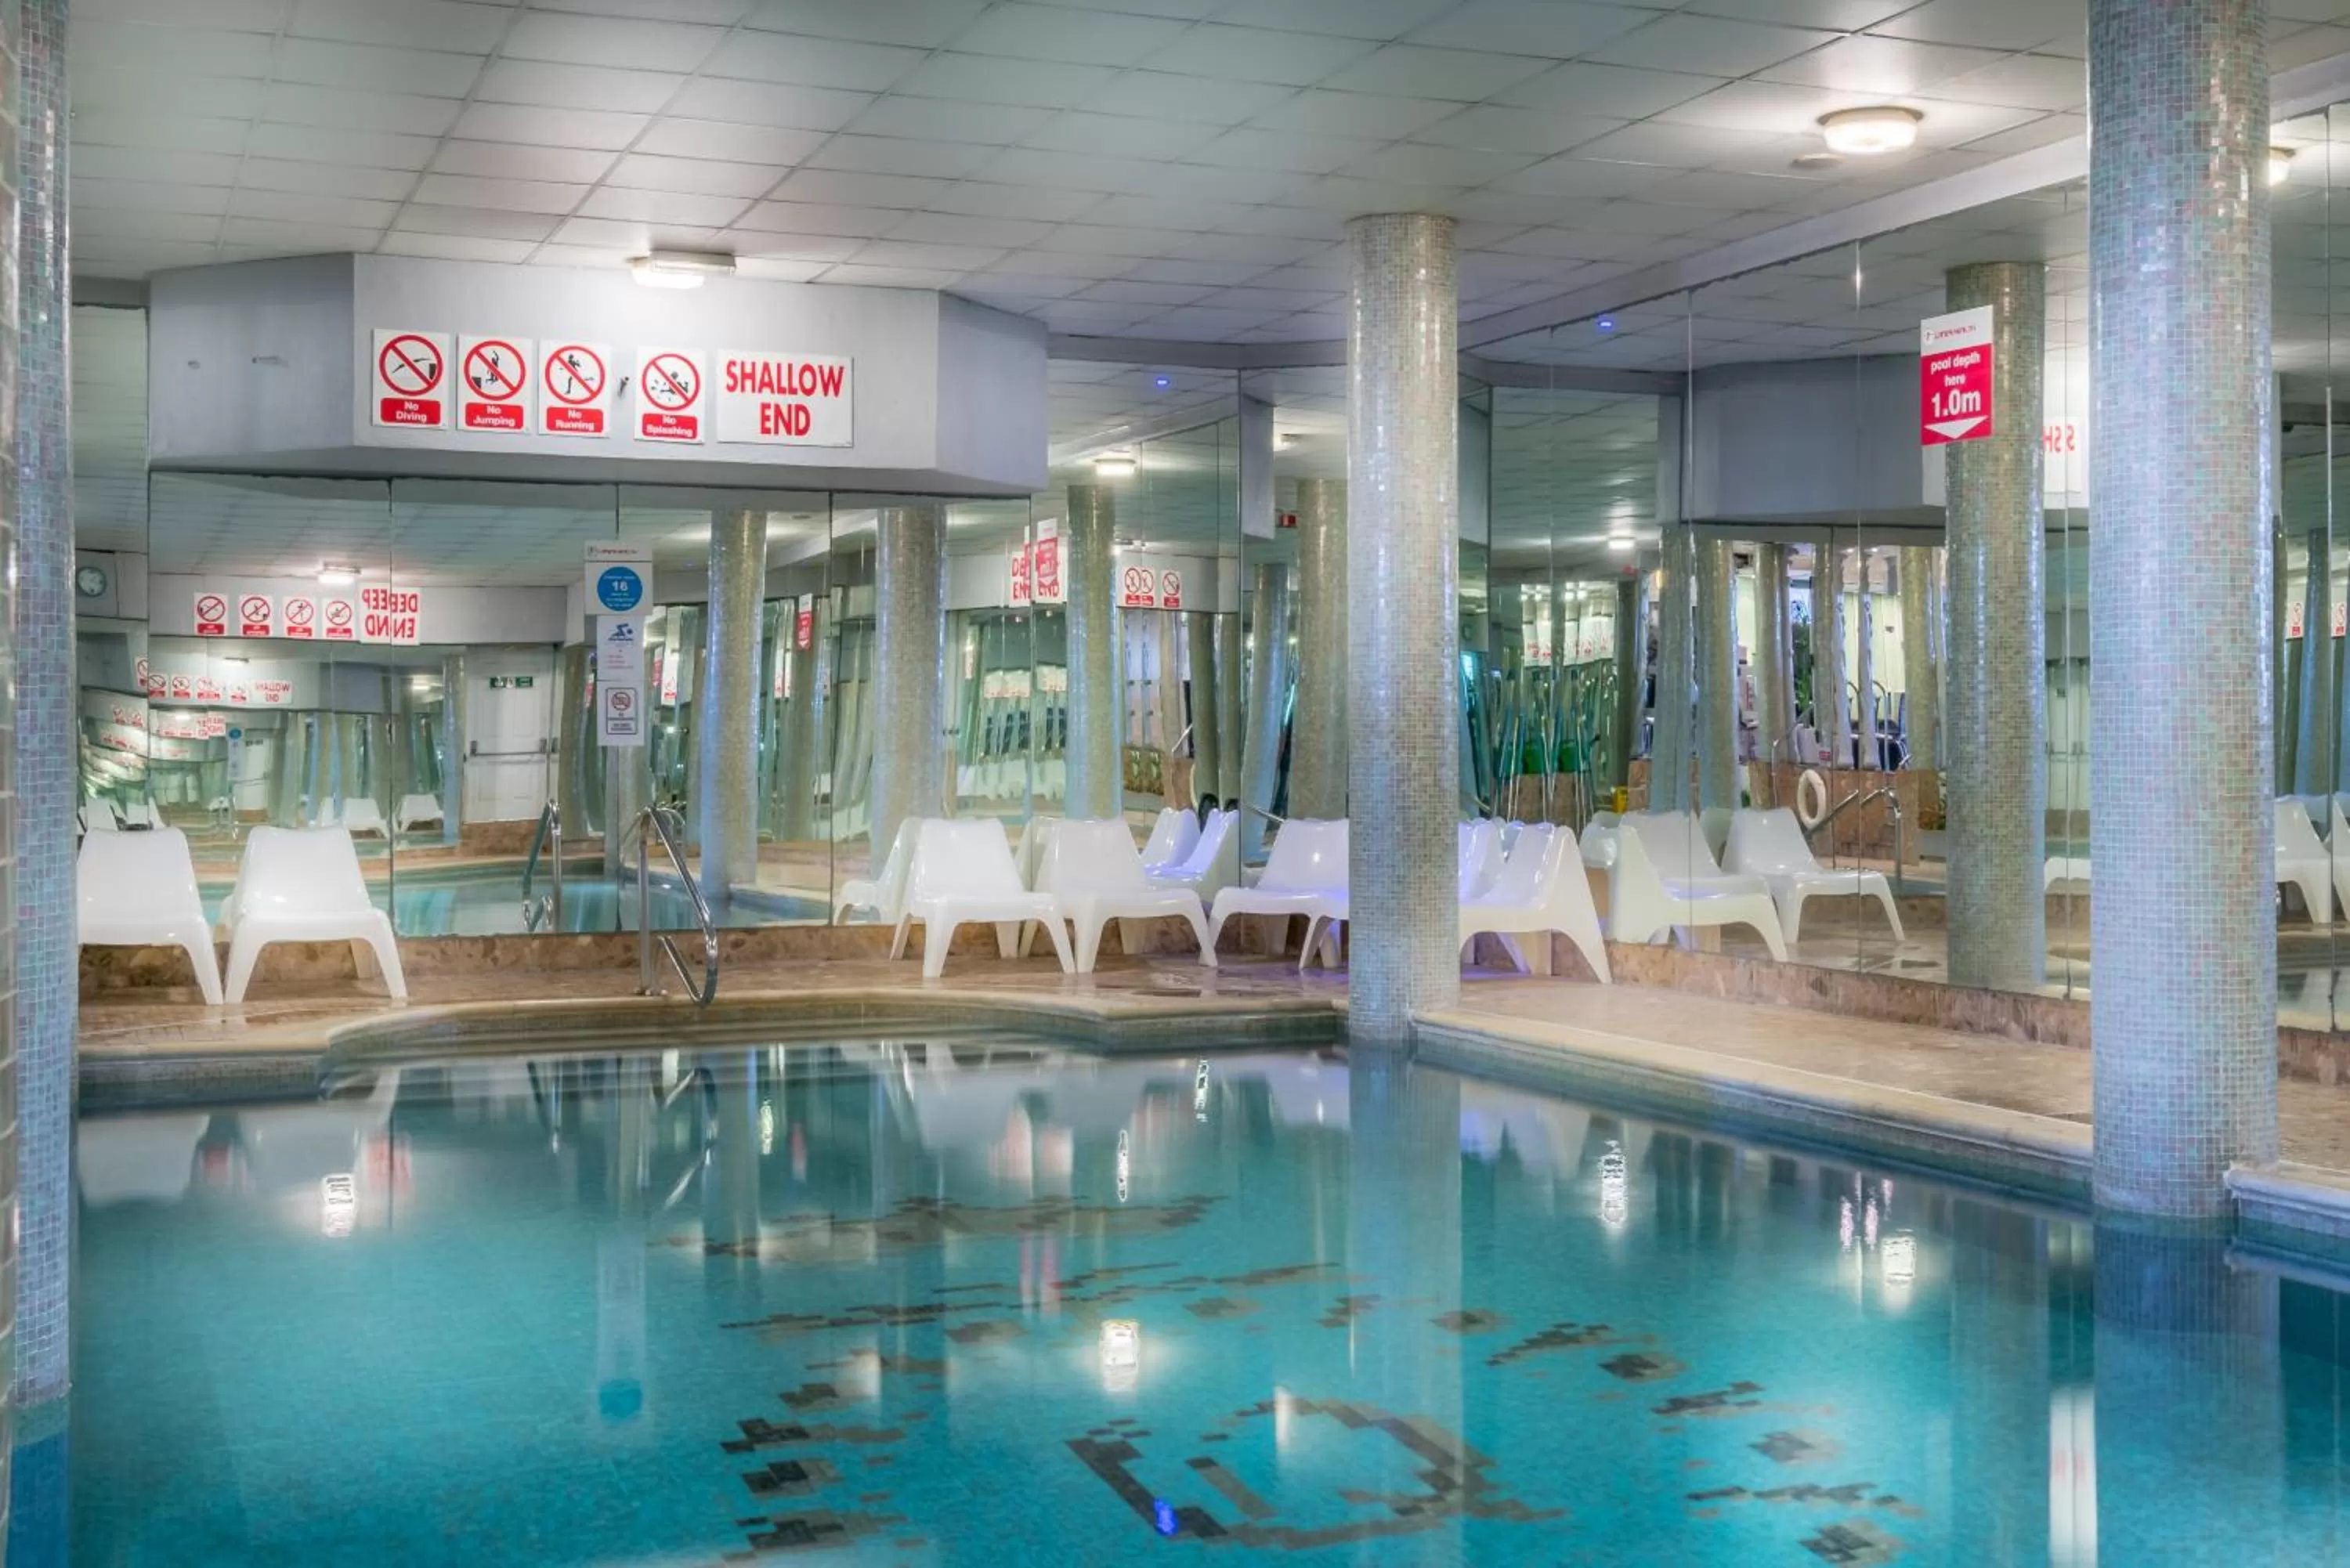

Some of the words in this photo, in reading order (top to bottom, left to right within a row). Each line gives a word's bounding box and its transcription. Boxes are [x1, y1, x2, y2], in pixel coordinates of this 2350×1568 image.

[1930, 356, 1951, 375] pool
[1953, 352, 1980, 369] depth
[725, 359, 845, 398] SHALLOW
[1943, 374, 1966, 387] here
[403, 401, 419, 410] No
[1931, 388, 1981, 417] 1.0m
[486, 405, 501, 414] No
[568, 409, 582, 418] No
[396, 410, 427, 422] Diving
[473, 416, 515, 427] Jumping
[663, 414, 677, 424] No
[760, 402, 811, 436] END
[555, 419, 595, 431] Running
[646, 425, 693, 437] Splashing
